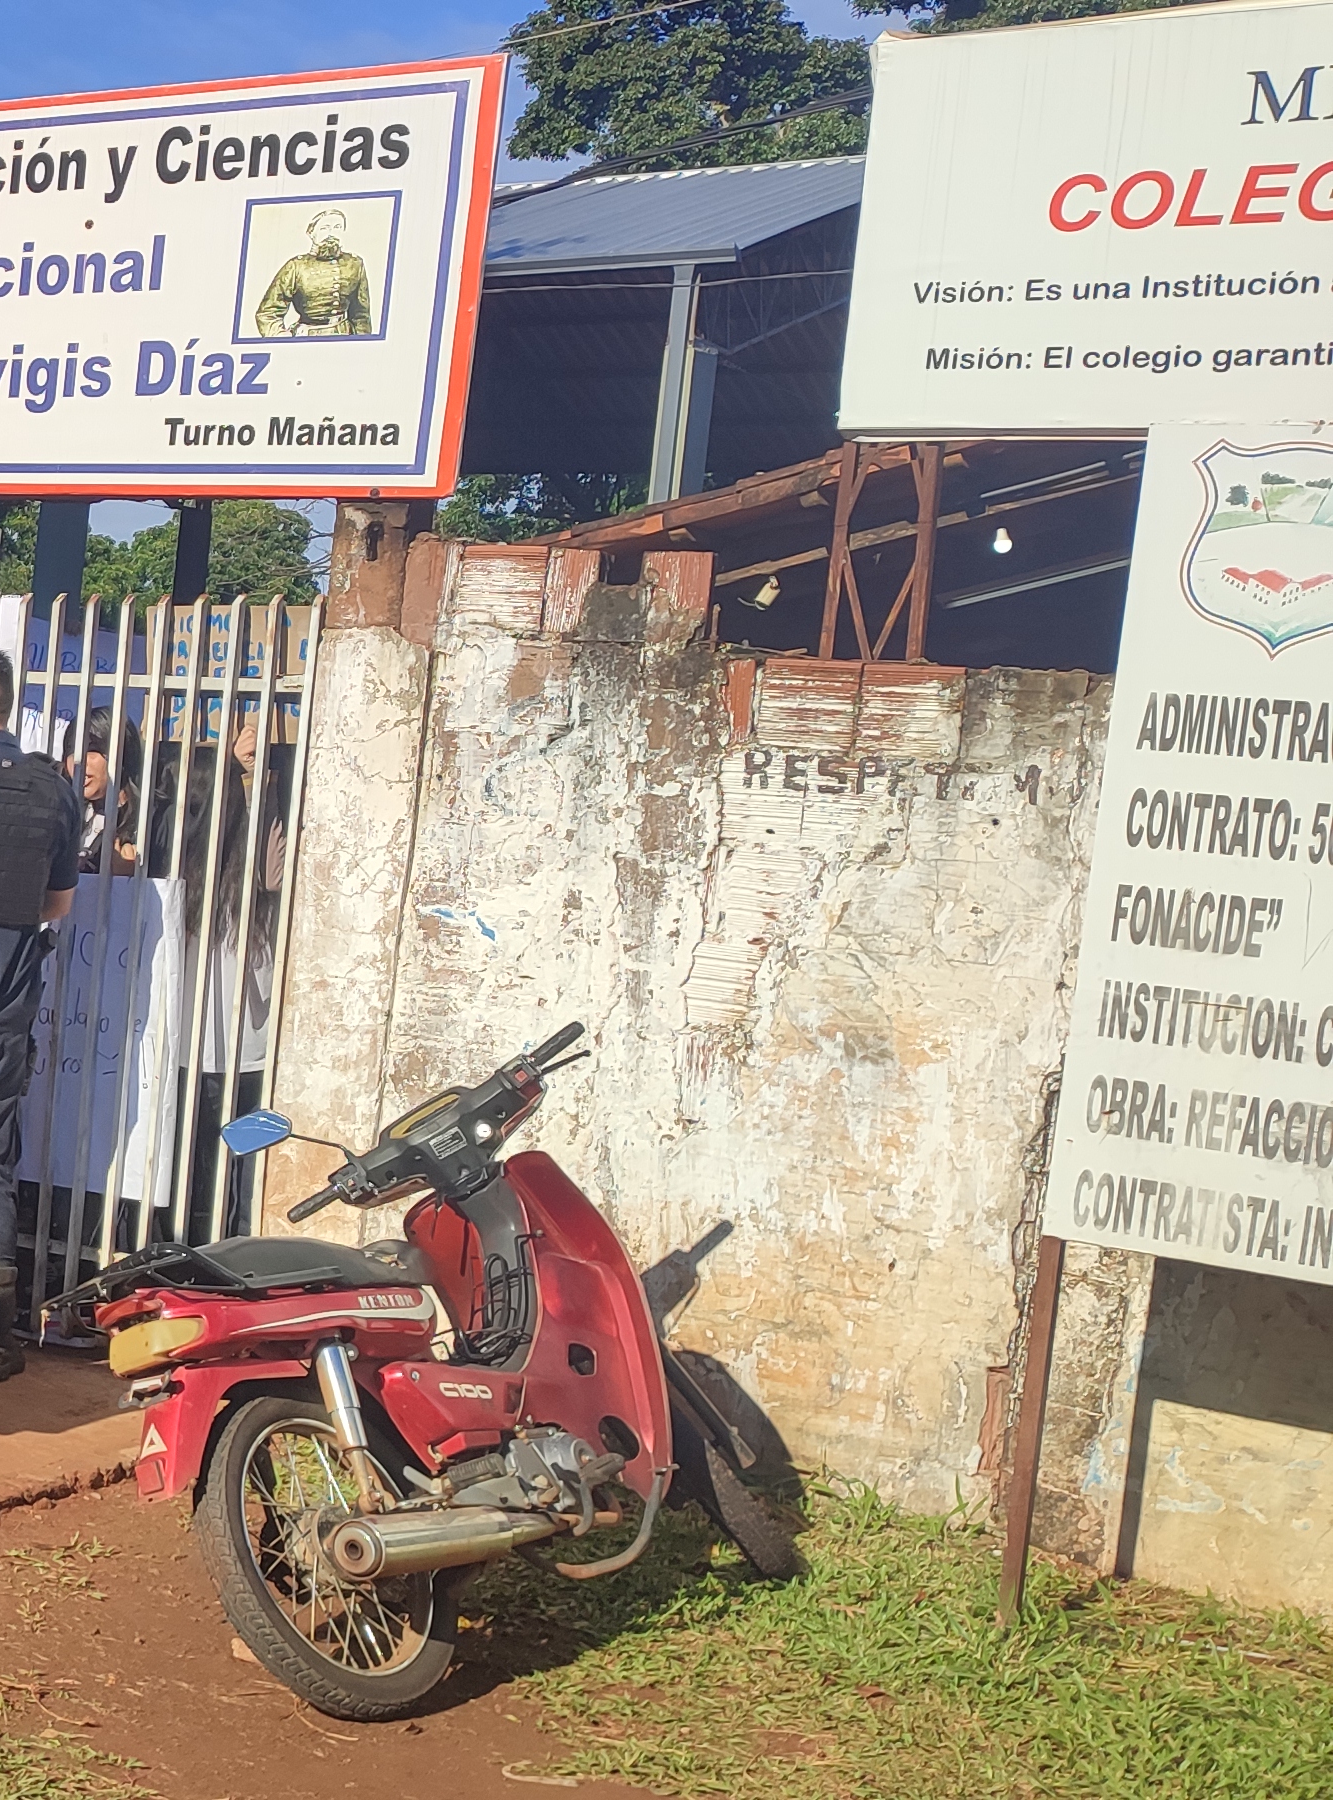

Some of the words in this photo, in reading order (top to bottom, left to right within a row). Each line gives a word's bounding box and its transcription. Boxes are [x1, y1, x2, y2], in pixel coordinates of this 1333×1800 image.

[1241, 65, 1333, 125] M
[105, 145, 138, 203] y
[156, 113, 410, 184] Ciencias
[913, 280, 1014, 304] Visión:
[1024, 278, 1062, 301] Es
[1073, 277, 1131, 300] una
[1141, 270, 1321, 299] Institución
[134, 338, 271, 397] Díaz
[925, 346, 1033, 370] Misión:
[1044, 345, 1073, 369] El
[1082, 344, 1203, 374] colegio
[164, 417, 255, 446] Turno
[267, 416, 400, 446] Mañana
[1135, 691, 1333, 764] ADMINISTRA
[1126, 787, 1302, 862] CONTRATO:
[1097, 978, 1307, 1064] INSTITUCION:
[1086, 1074, 1178, 1145] OBRA:
[1073, 1169, 1293, 1262] CONTRATISTA:
[357, 1294, 416, 1309] KENTON
[439, 1382, 493, 1400] C100
